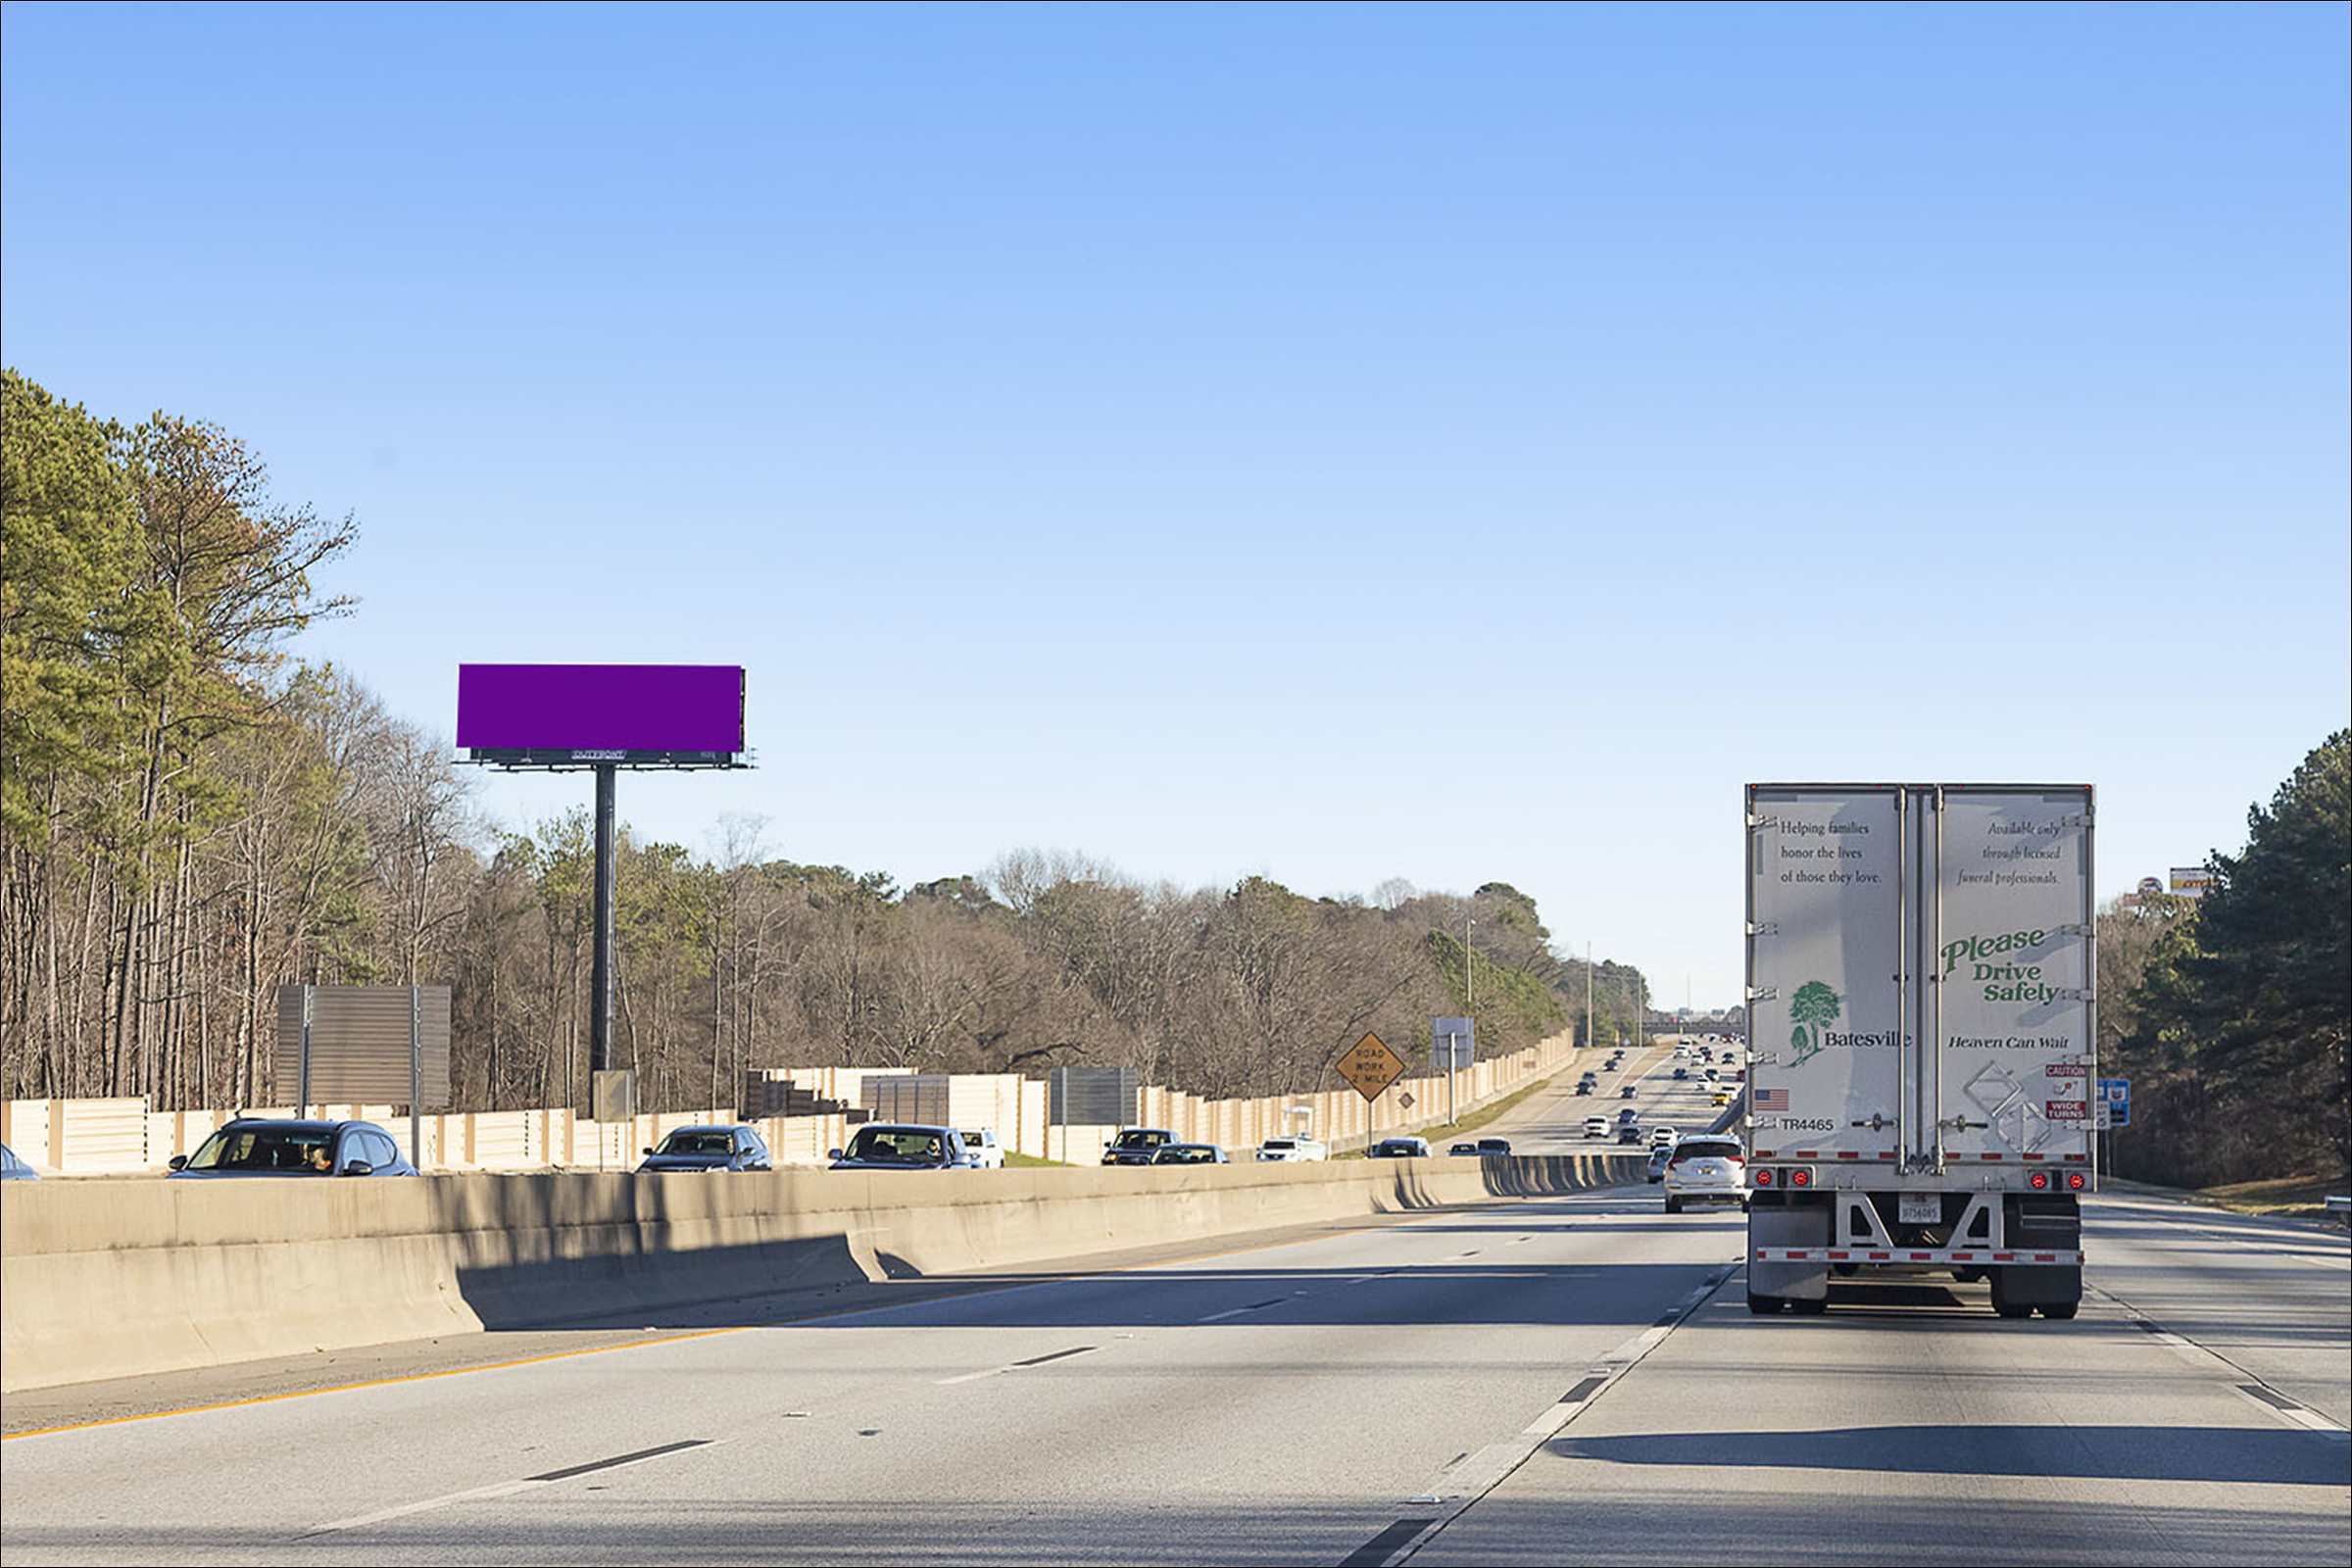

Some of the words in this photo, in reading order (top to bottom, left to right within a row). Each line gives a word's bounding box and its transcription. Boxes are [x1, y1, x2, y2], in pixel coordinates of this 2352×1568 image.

[1781, 821, 1826, 837] Helping
[1829, 821, 1870, 834] families
[1987, 821, 2035, 836] Available
[2037, 821, 2060, 838] only
[1781, 846, 1814, 858] honor
[1817, 846, 1835, 858] the
[1838, 846, 1863, 858] lives
[1983, 846, 2022, 861] through
[2024, 846, 2061, 859] licensed
[1781, 870, 1793, 883] of
[1795, 870, 1826, 883] those
[1829, 870, 1853, 886] they
[1855, 870, 1883, 883] love.
[1956, 868, 1994, 887] funeral
[1939, 929, 2046, 974] Please
[1972, 961, 2042, 981] Drive
[1983, 981, 2061, 1006] Safely
[1824, 1030, 1914, 1048] Batesville
[1948, 1036, 2003, 1049] Heaven
[2006, 1036, 2035, 1049] Can
[2038, 1036, 2070, 1049] Wait
[1355, 1049, 1385, 1058] ROAD
[1355, 1061, 1385, 1071] WORK
[2046, 1066, 2085, 1076] CAUTION
[2048, 1109, 2085, 1118] TURNS
[2051, 1102, 2082, 1110] WIDE
[1782, 1118, 1835, 1132] TR4465
